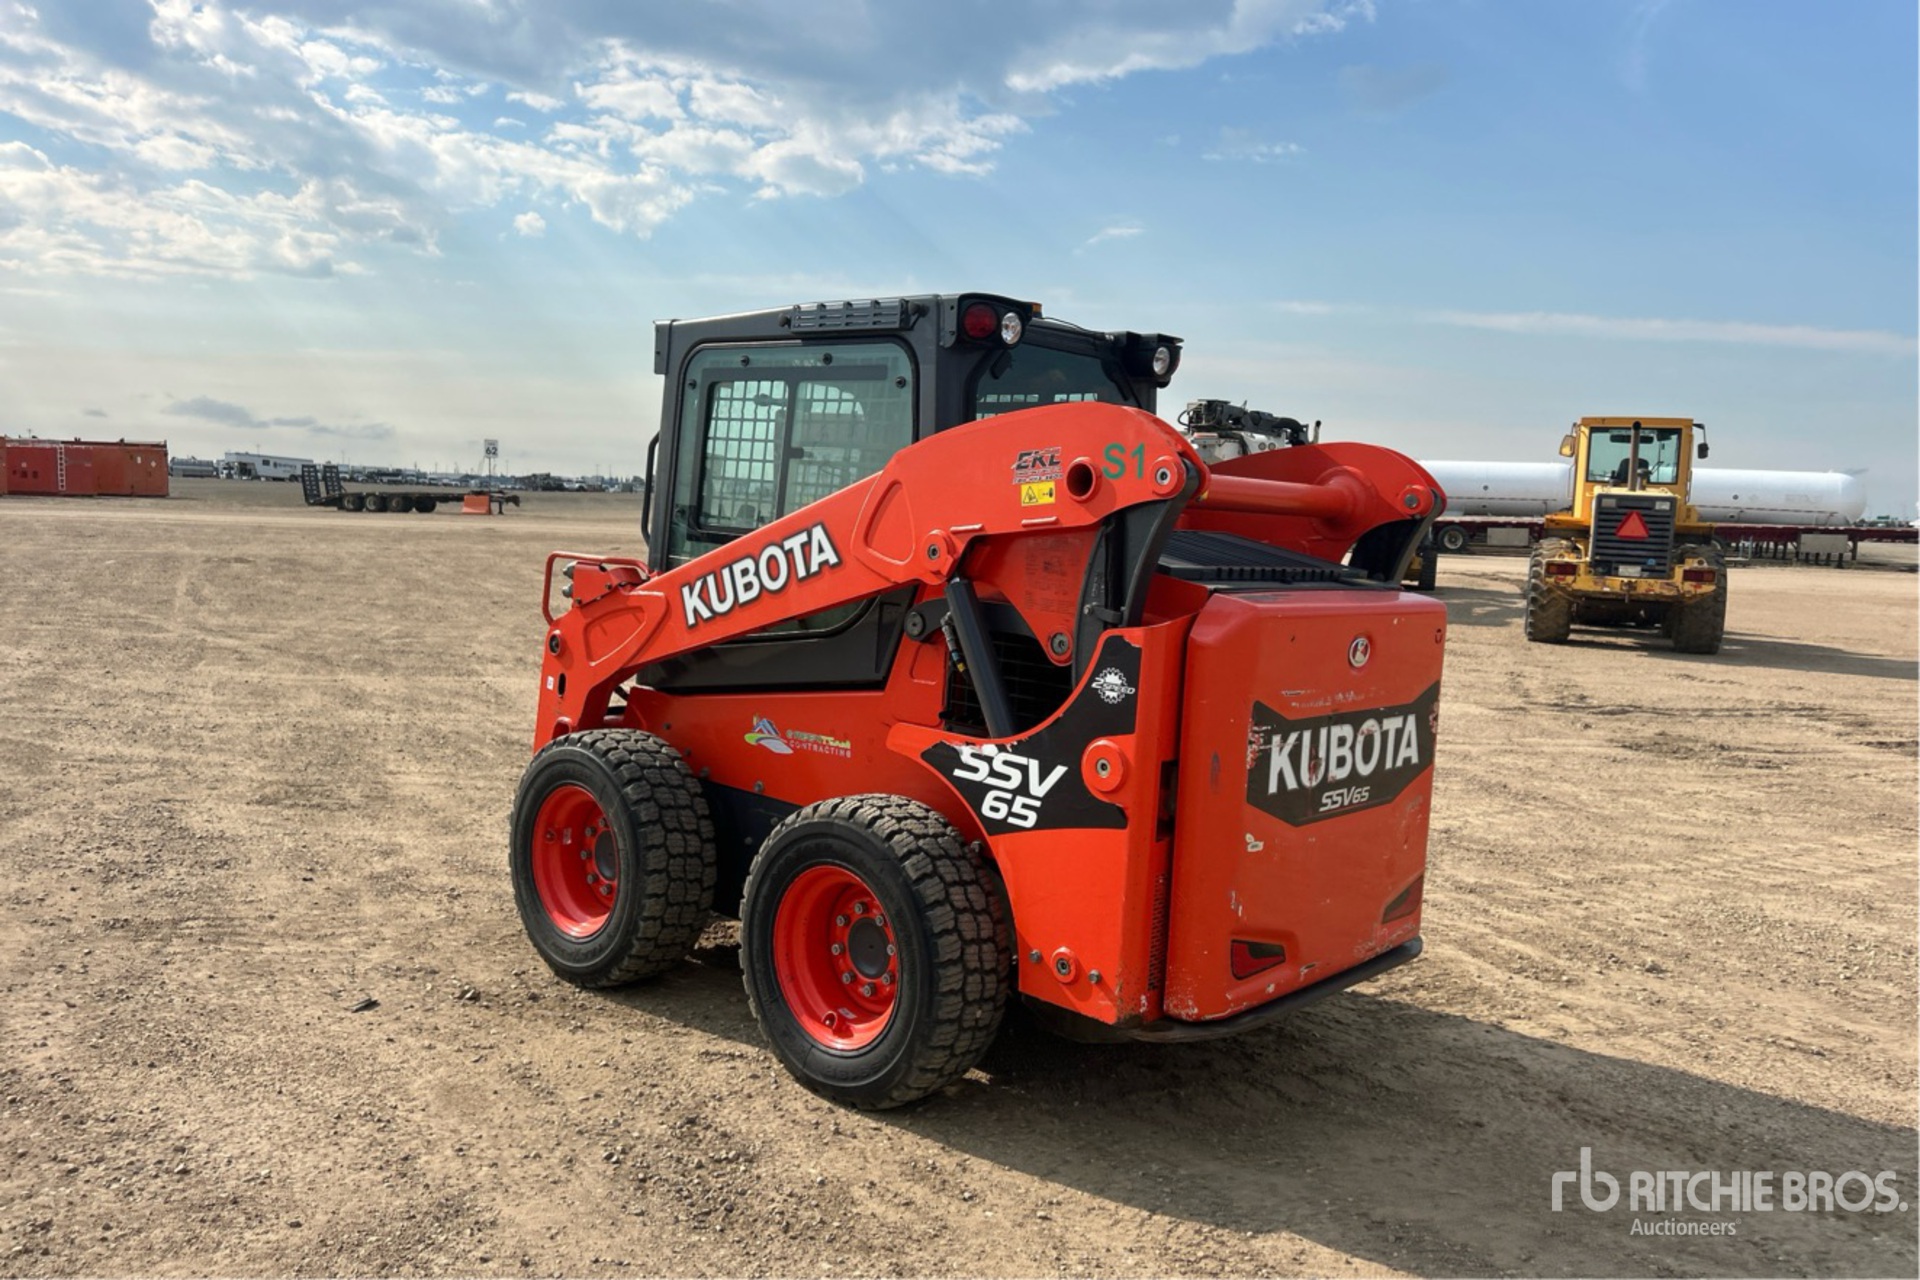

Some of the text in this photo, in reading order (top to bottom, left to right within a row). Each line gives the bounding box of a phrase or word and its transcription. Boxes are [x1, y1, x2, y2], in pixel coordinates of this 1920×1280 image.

[486, 446, 498, 456] 62
[1102, 442, 1145, 479] S1
[680, 522, 841, 627] KUBOTA
[788, 740, 852, 758] CONTRACTING
[1268, 713, 1419, 795] KUBOTA
[952, 746, 1069, 798] SSV
[981, 790, 1042, 829] 65
[1319, 786, 1371, 812] SSV65
